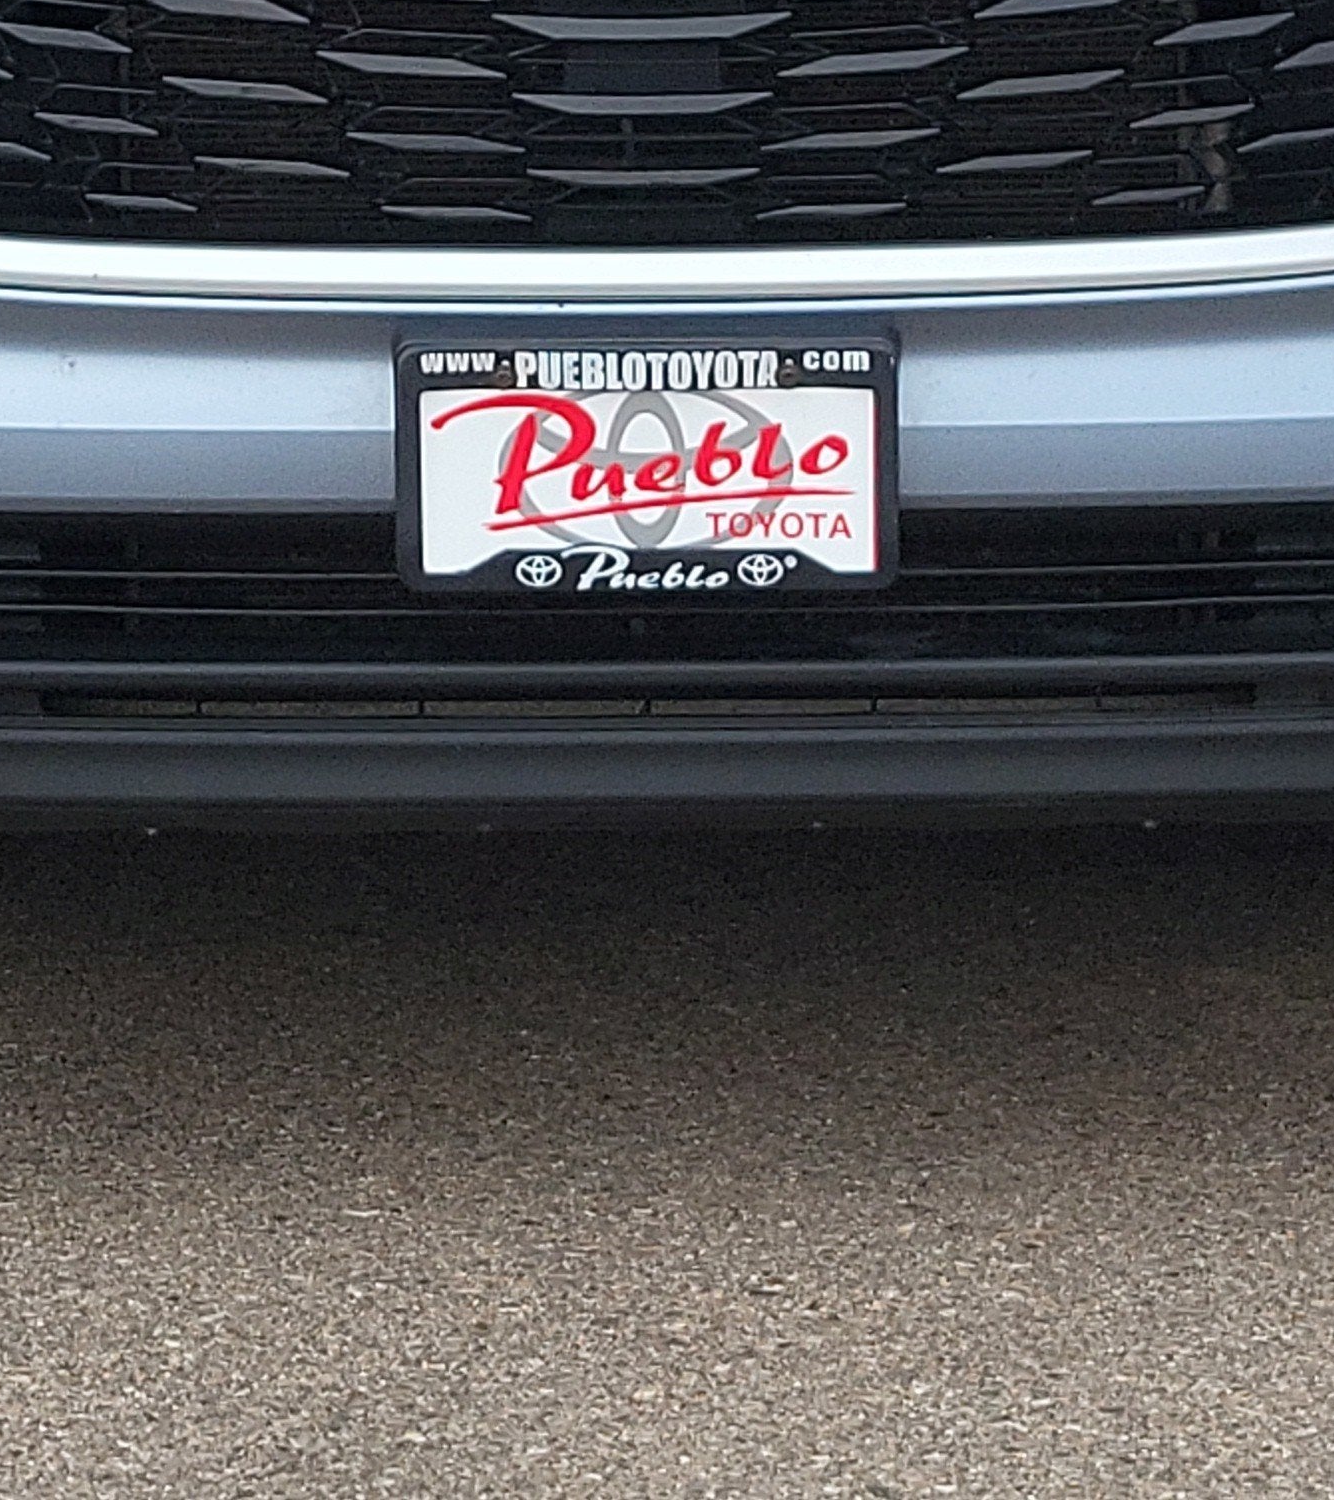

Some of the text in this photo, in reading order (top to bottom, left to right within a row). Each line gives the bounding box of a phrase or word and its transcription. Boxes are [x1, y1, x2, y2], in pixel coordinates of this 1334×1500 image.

[430, 393, 848, 514] Pueblo
[706, 512, 852, 539] TOYOTA
[560, 544, 730, 591] Pueblo
